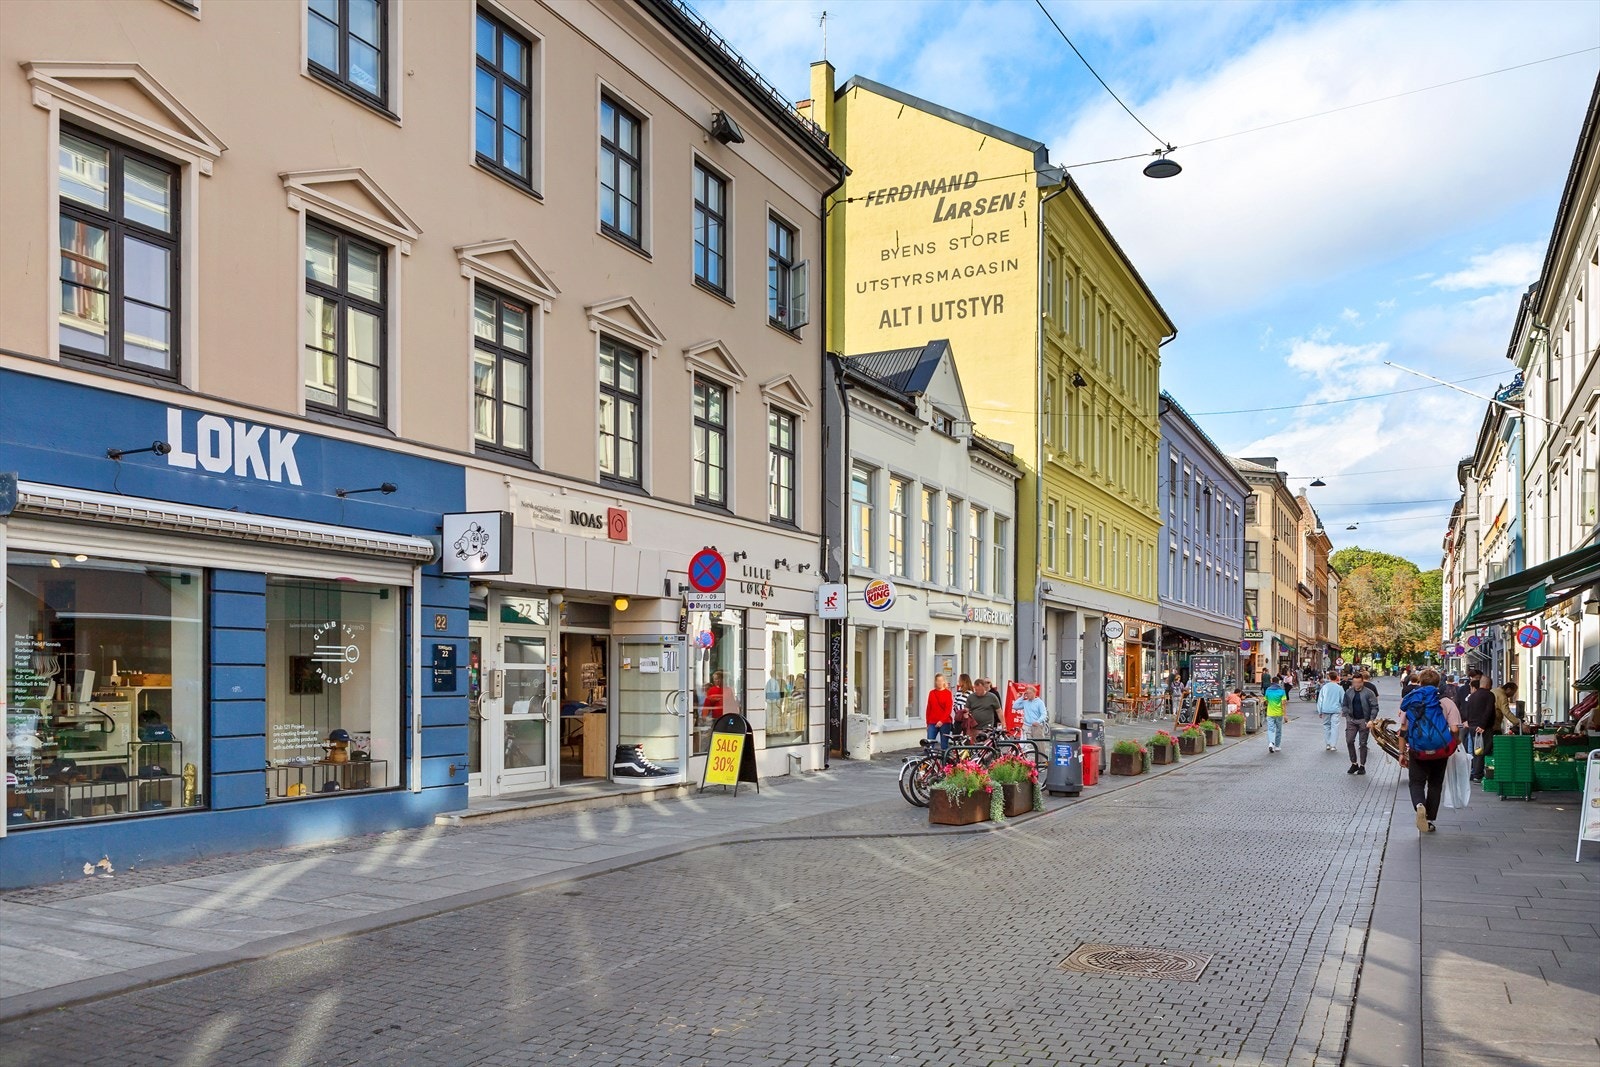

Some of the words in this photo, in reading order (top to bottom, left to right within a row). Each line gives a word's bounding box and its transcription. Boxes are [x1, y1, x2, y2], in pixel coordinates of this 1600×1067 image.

[865, 171, 979, 207] FERDINAND
[933, 192, 1016, 223] LARSEN
[881, 241, 936, 261] BYENS
[949, 230, 1010, 251] STORE
[856, 258, 1018, 294] UTSTYRSMAGASIN
[878, 306, 912, 330] ALT
[918, 305, 922, 324] I
[932, 294, 1004, 322] UTSTYR
[167, 407, 302, 486] LOKK
[570, 510, 603, 529] NOAS
[743, 565, 771, 580] LILLE
[867, 584, 889, 596] BURGER
[867, 590, 890, 604] KING
[518, 604, 531, 618] 22
[974, 608, 999, 624] BURGER
[999, 612, 1013, 626] KING
[314, 621, 336, 640] CLUB
[342, 624, 356, 639] 121
[436, 616, 446, 628] 22
[316, 668, 354, 684] PROJECT
[716, 739, 738, 752] SALG
[713, 756, 735, 772] 30%
